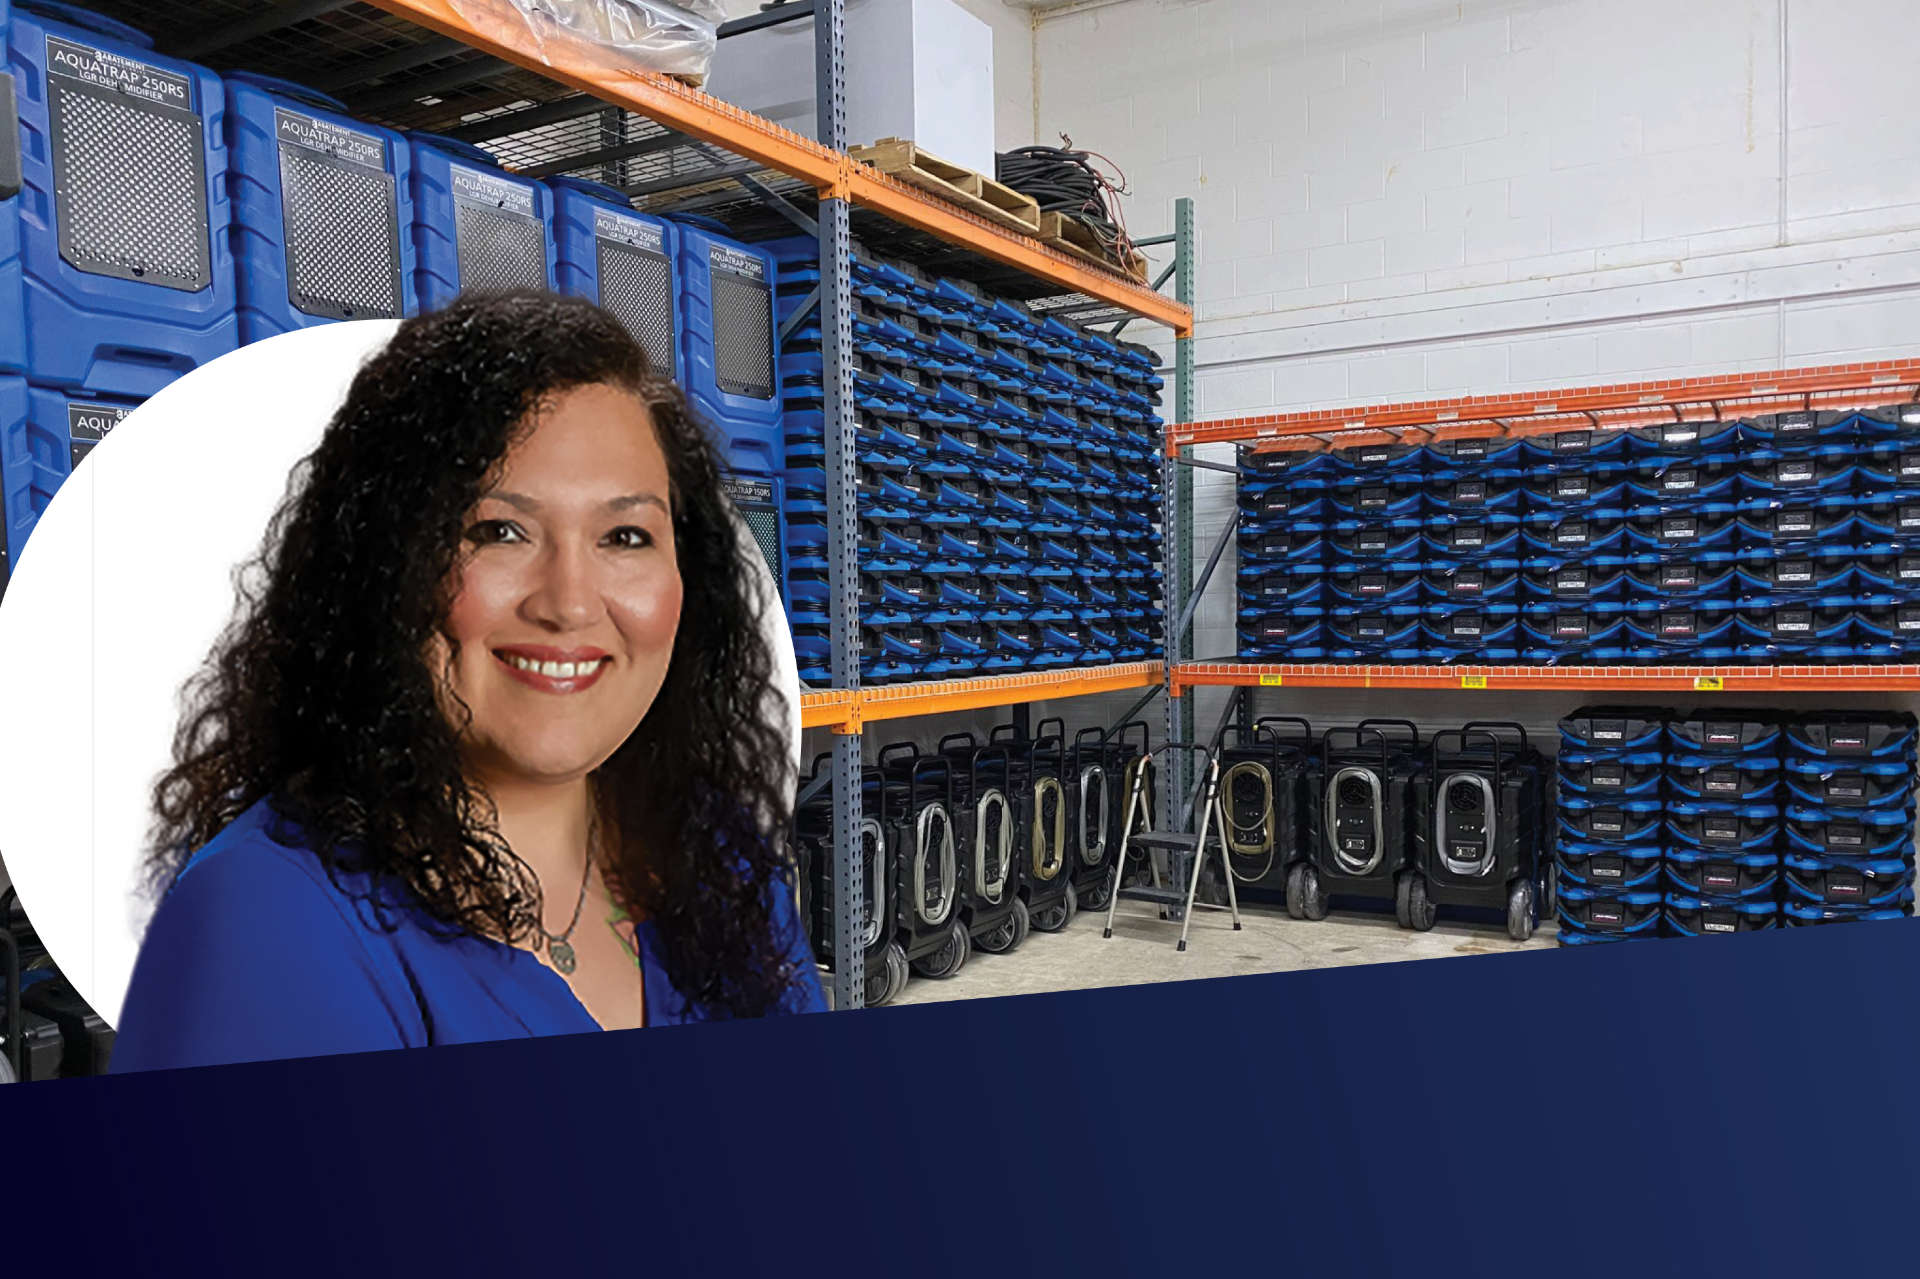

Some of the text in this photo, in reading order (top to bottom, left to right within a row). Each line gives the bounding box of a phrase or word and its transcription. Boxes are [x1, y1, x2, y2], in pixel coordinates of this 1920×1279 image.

[54, 50, 138, 83] AQUATRAP
[143, 76, 184, 98] 250RS
[79, 70, 163, 101] LGR DEHMIDIFIER
[281, 120, 380, 159] AQUATRAP 250RS
[454, 176, 504, 198] AQUATRAP
[505, 191, 531, 208] 250RS
[596, 218, 639, 237] AQUATRAP
[639, 231, 661, 246] 250RS
[710, 251, 744, 268] AQUATRAP
